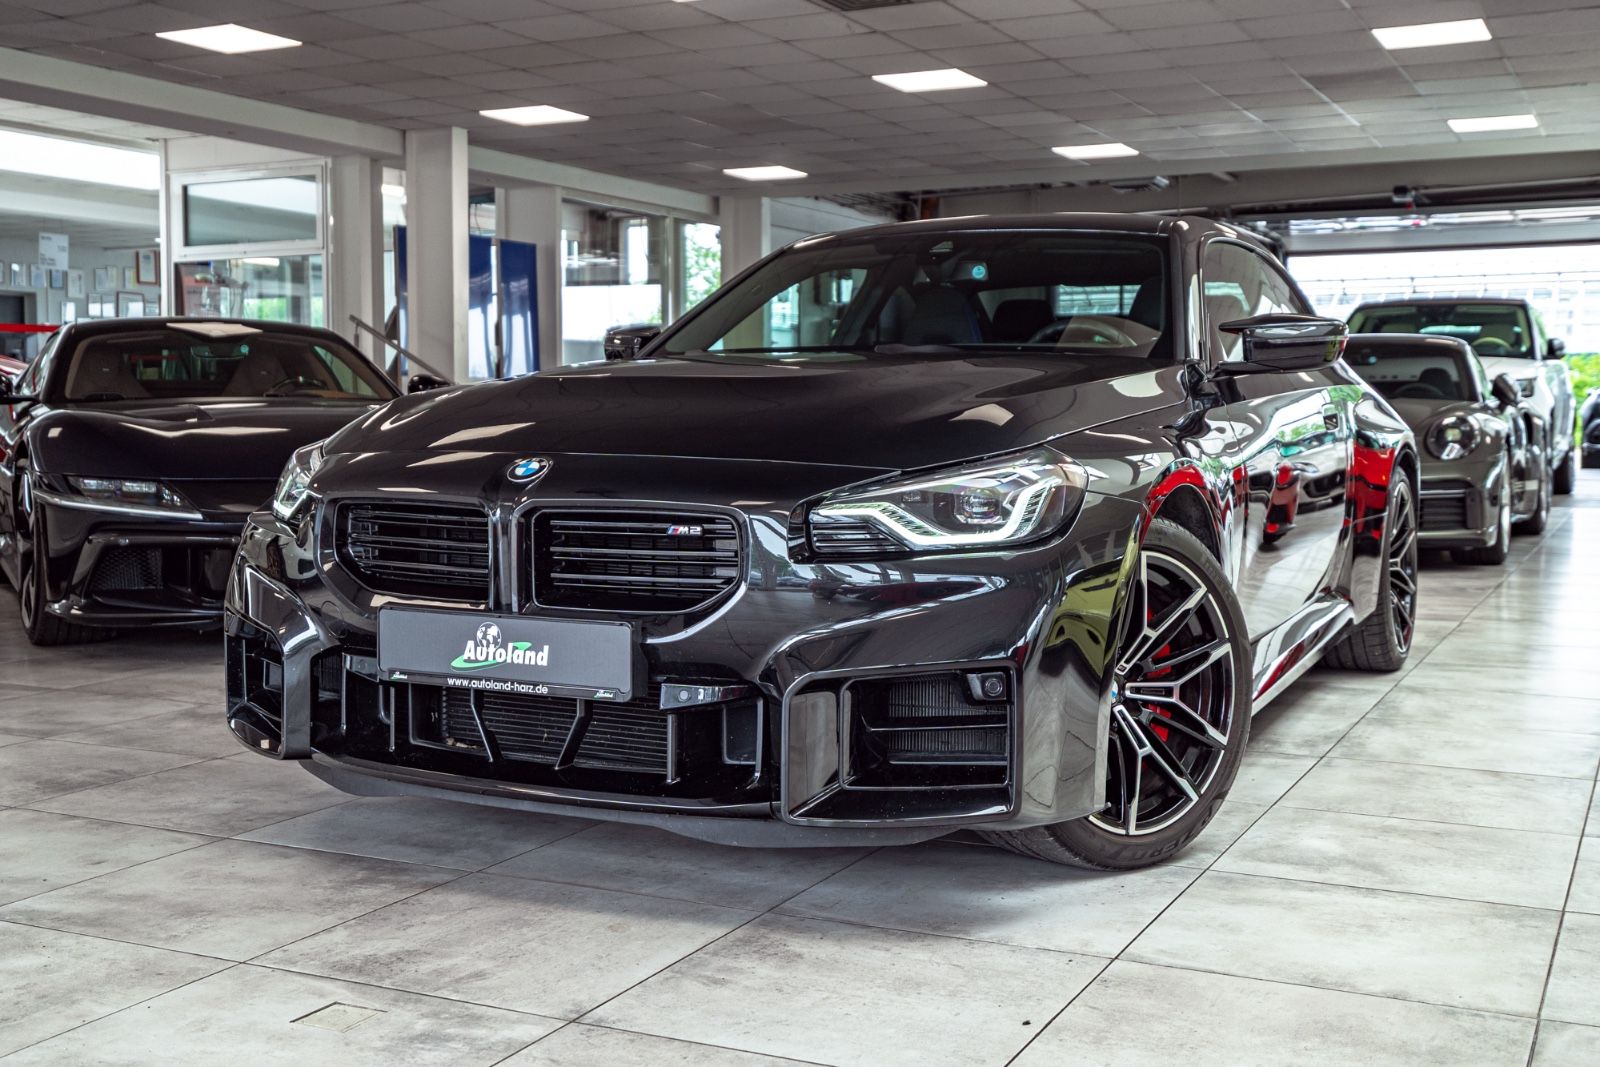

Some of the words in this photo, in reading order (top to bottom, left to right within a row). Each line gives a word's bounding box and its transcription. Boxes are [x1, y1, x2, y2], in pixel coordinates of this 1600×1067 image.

[679, 526, 701, 535] M2
[463, 640, 549, 666] Autoland
[447, 678, 549, 694] www.autoland-harz.de
